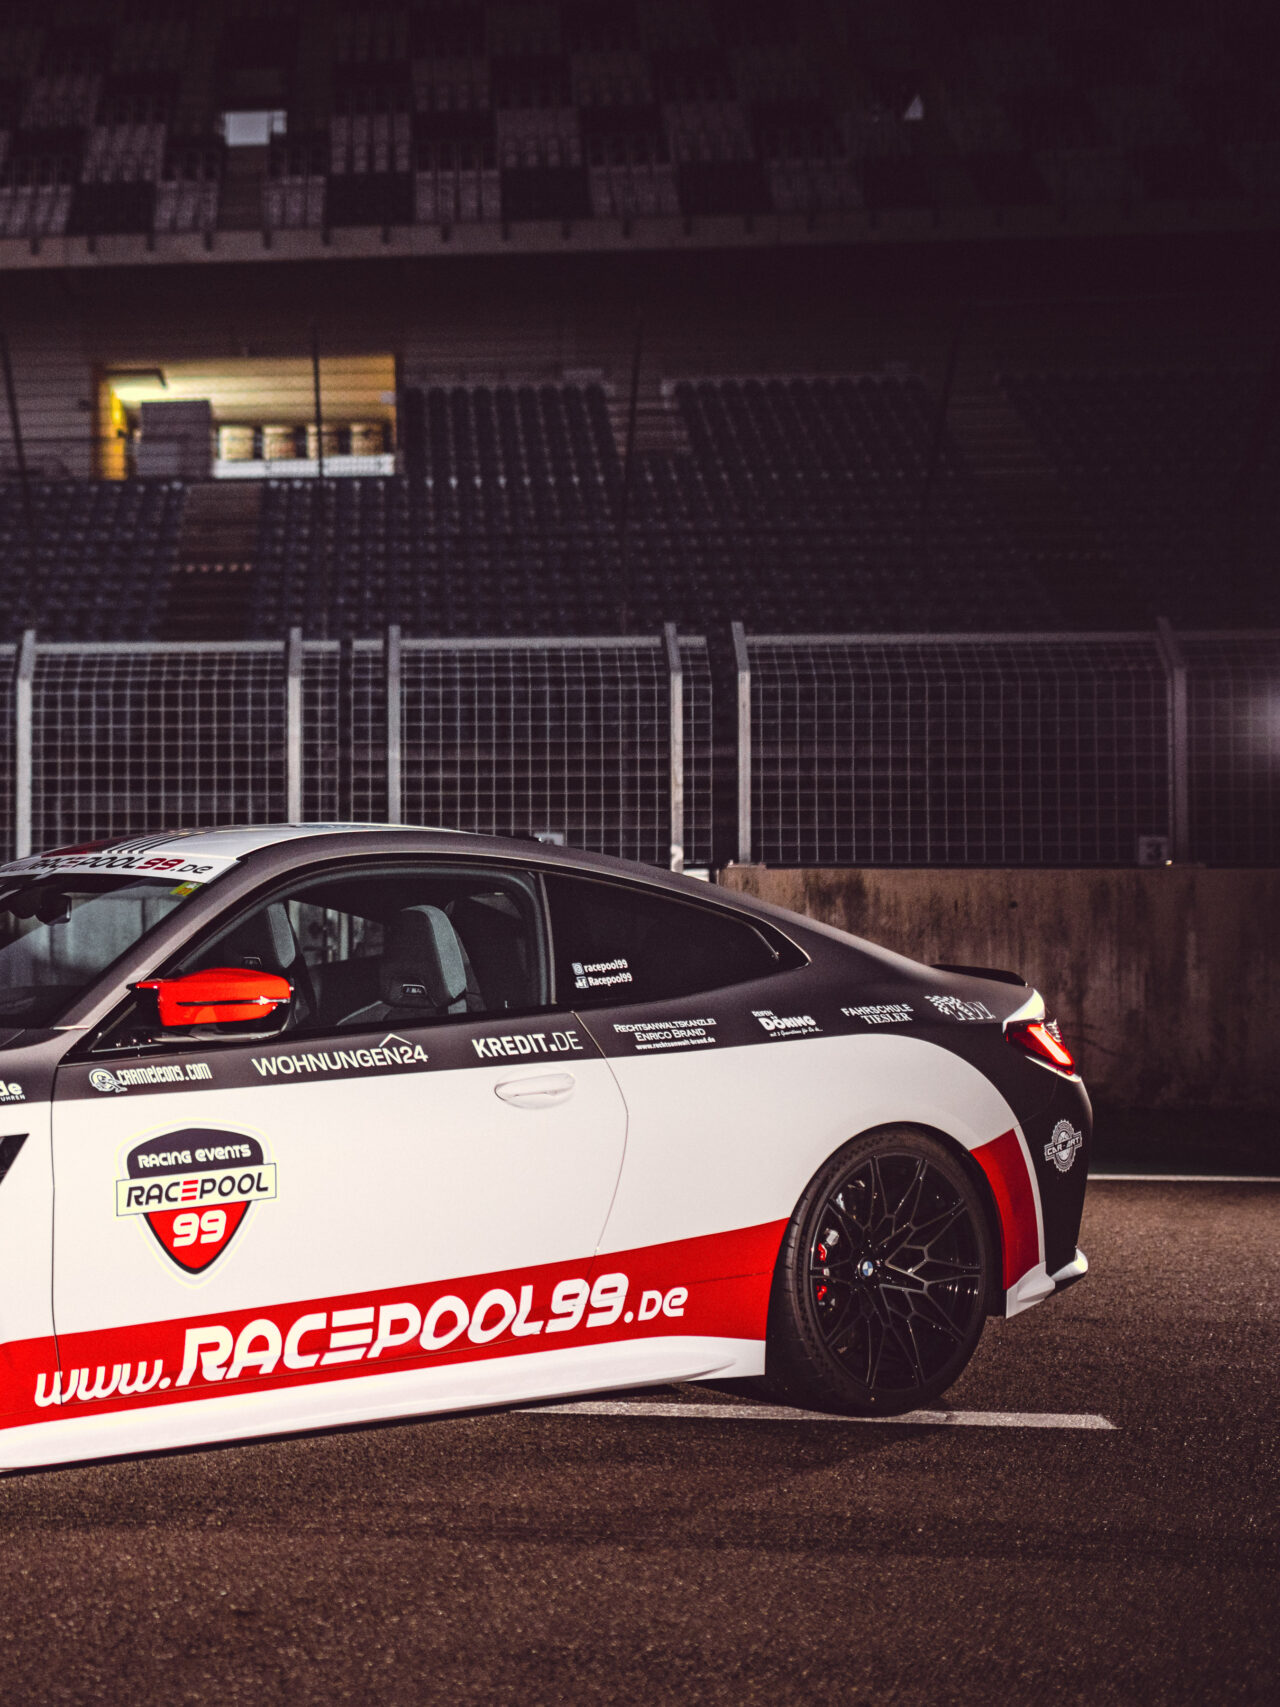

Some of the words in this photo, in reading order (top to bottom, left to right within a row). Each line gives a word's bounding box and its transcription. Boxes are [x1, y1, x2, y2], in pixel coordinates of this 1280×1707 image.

[583, 958, 629, 973] racepool99
[587, 972, 633, 987] Racepool99
[840, 1003, 915, 1017] FAHRSCHULE
[758, 1015, 817, 1031] DÖRING
[860, 1012, 913, 1025] TIESLER
[471, 1031, 584, 1058] KREDIT.DE
[251, 1044, 429, 1077] WOHNUNGEN24
[126, 1172, 269, 1208] RACEPOOL
[172, 1209, 227, 1248] 99
